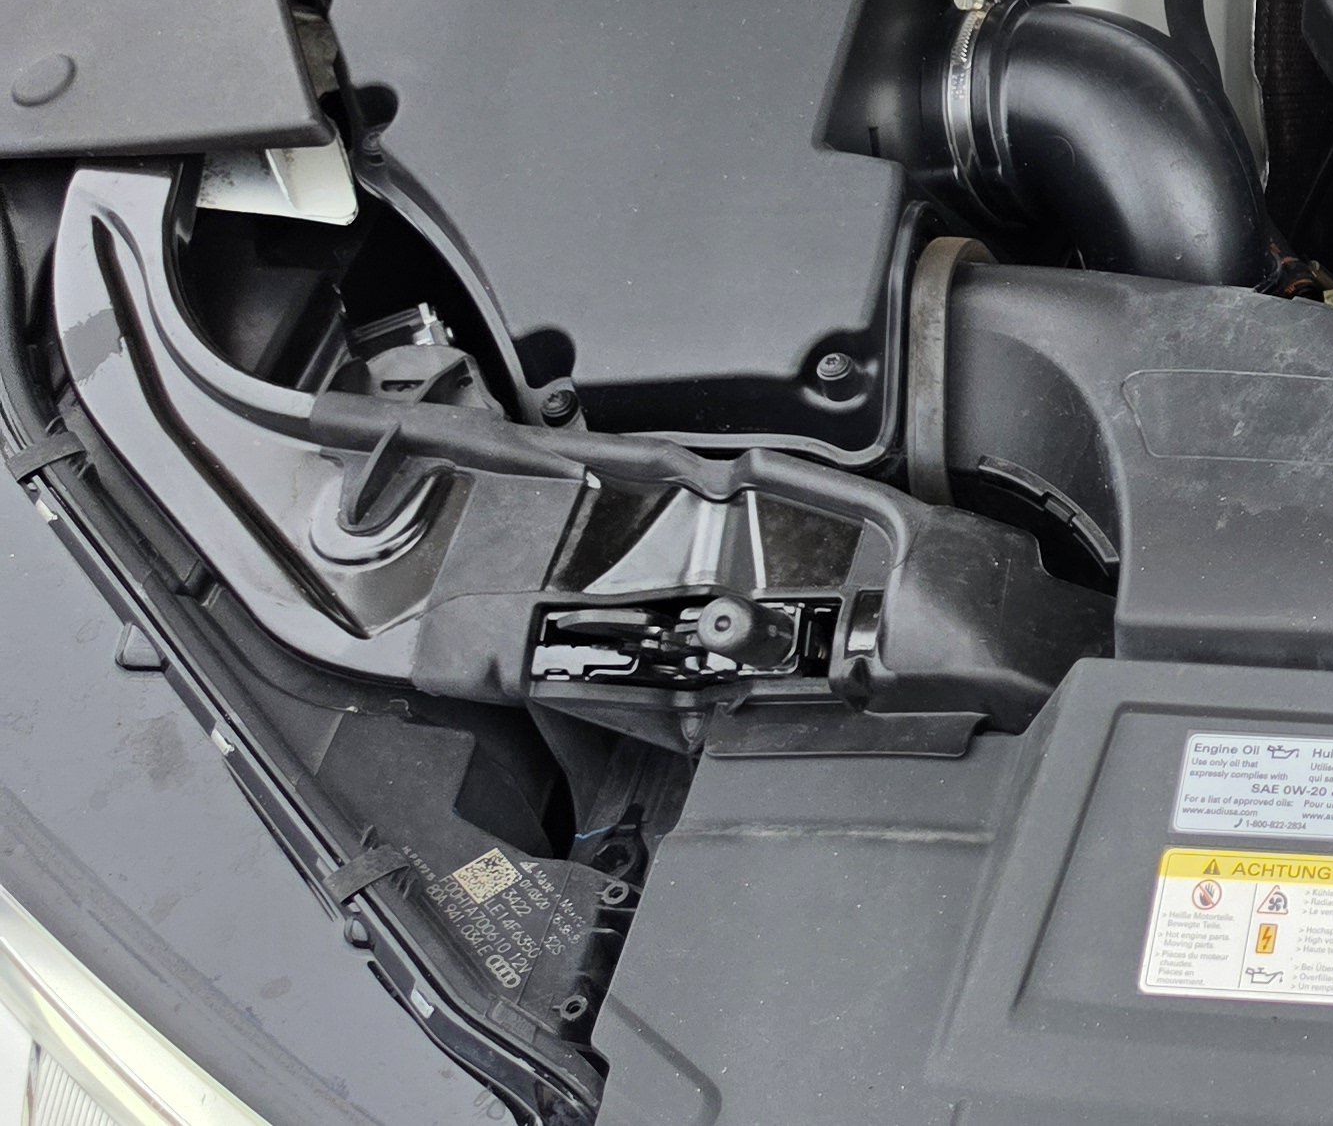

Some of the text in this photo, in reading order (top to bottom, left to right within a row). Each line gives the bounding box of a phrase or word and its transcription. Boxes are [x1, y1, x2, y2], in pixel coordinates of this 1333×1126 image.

[1194, 742, 1259, 756] Engine Oil
[1209, 759, 1227, 768] only
[1229, 759, 1240, 767] oil
[1242, 760, 1257, 768] that
[1189, 769, 1227, 778] expressly
[1230, 771, 1267, 780] complies
[1308, 774, 1322, 783] qui
[1251, 784, 1279, 794] SAE
[1283, 785, 1327, 796] 0W-20
[1184, 794, 1198, 803] For
[1207, 795, 1220, 803] list
[1223, 796, 1232, 804] of
[1234, 797, 1272, 807] approved
[1276, 798, 1293, 807] oils:
[1303, 800, 1324, 808] Pour
[1182, 805, 1257, 816] www.audiusa.com
[1245, 820, 1306, 830] 1-800-822-2834
[1231, 861, 1331, 880] ACHTUNG
[502, 890, 532, 915] 3422
